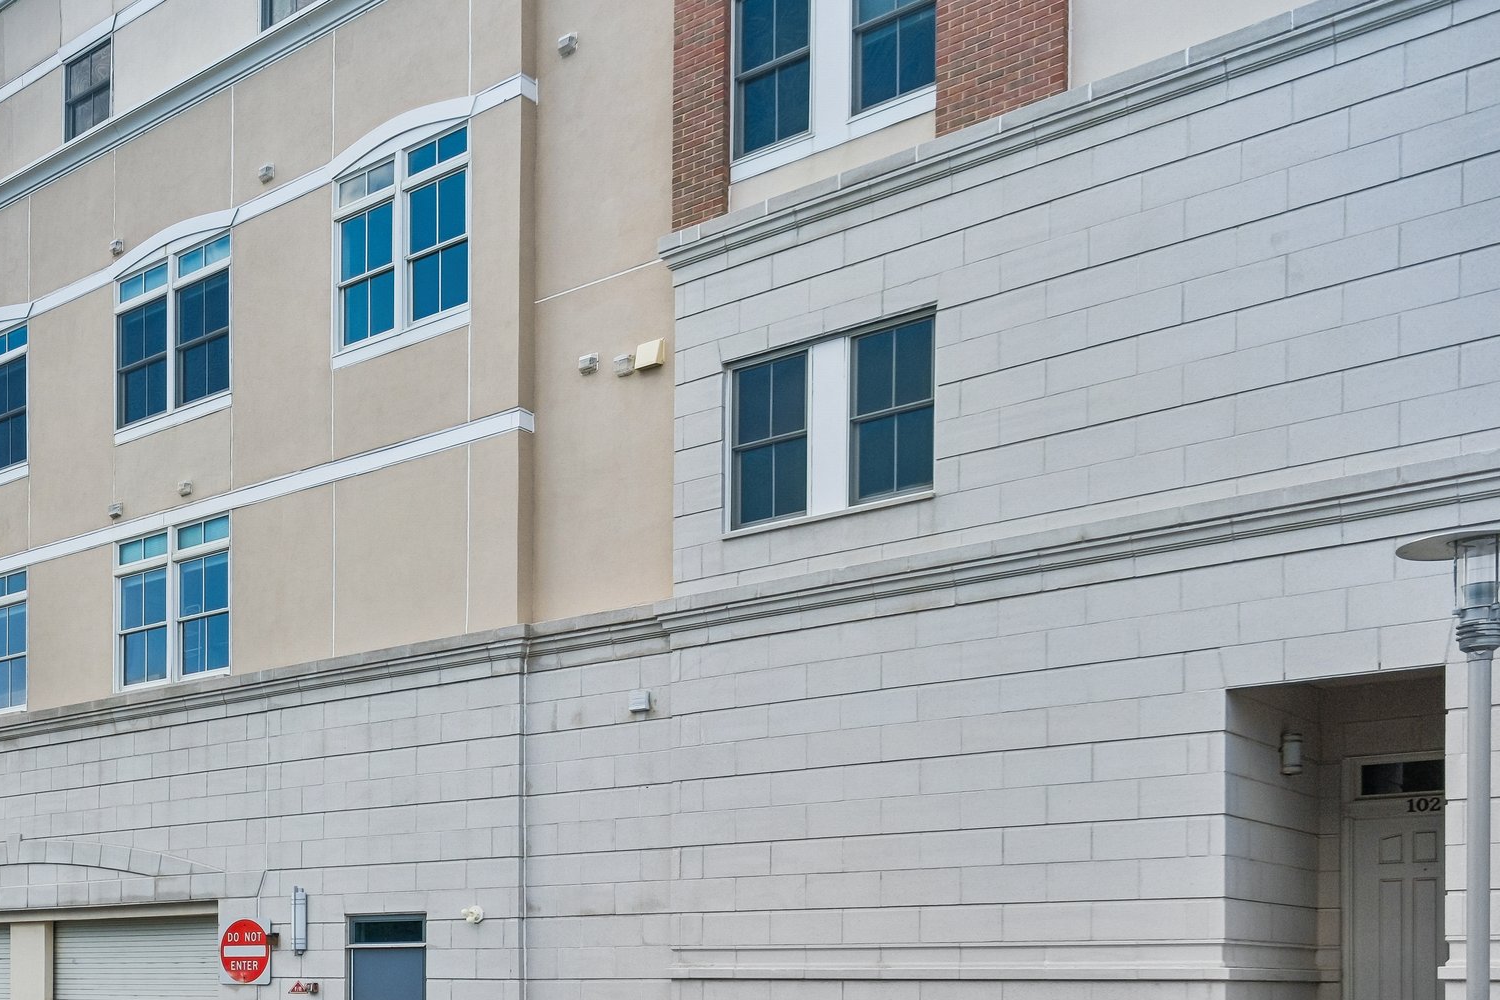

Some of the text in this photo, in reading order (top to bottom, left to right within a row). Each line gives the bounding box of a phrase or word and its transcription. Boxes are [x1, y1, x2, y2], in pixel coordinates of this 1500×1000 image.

[1407, 797, 1441, 813] 102
[227, 931, 262, 942] DO NOT
[230, 960, 259, 971] ENTER
